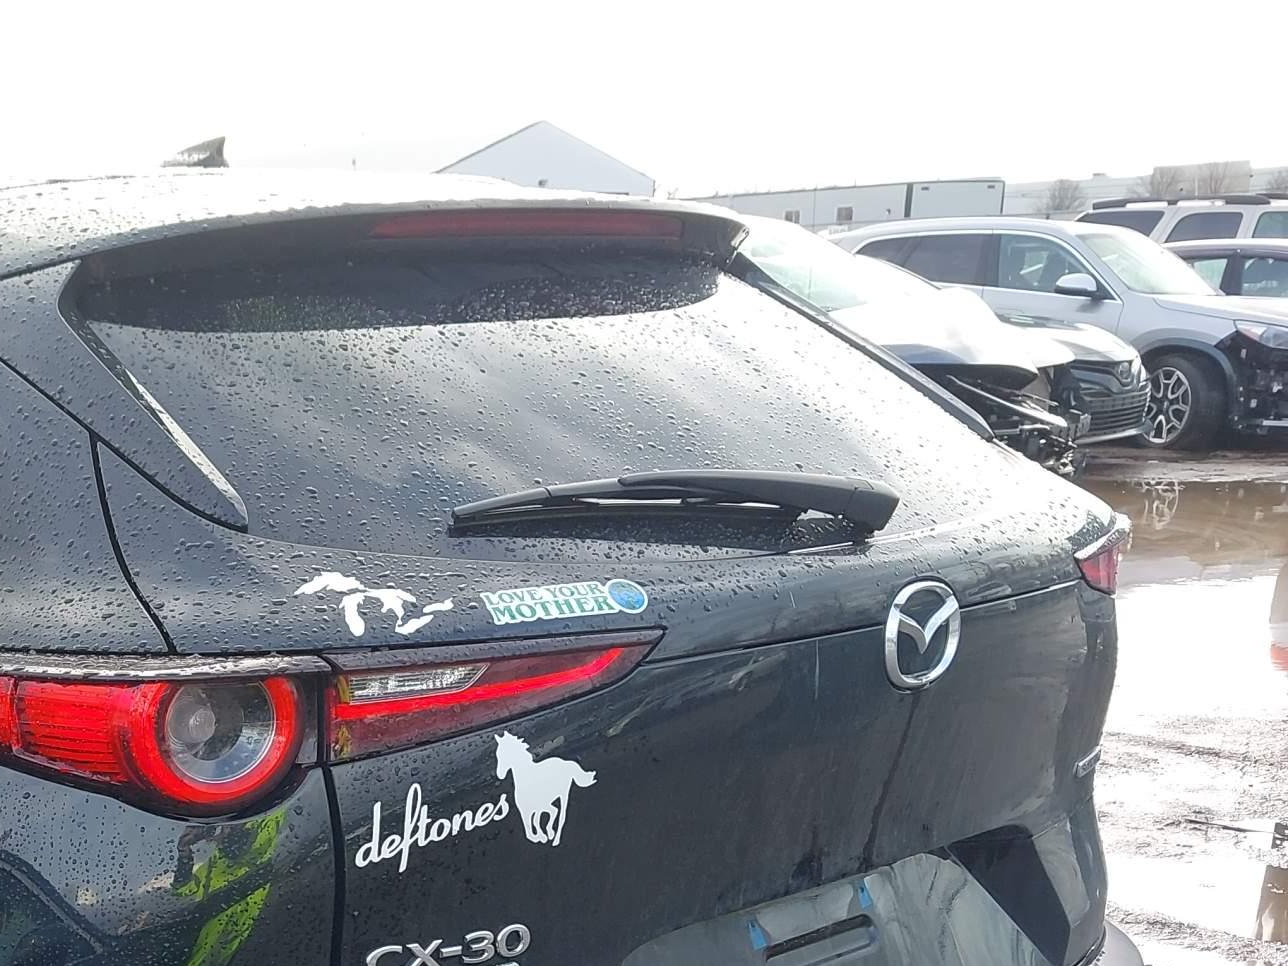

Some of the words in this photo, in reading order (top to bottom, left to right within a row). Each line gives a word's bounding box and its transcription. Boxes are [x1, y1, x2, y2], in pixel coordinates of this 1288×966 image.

[484, 588, 543, 606] LOVE
[546, 583, 605, 599] YOUR
[490, 595, 616, 622] MOTHER
[355, 783, 509, 873] deftones
